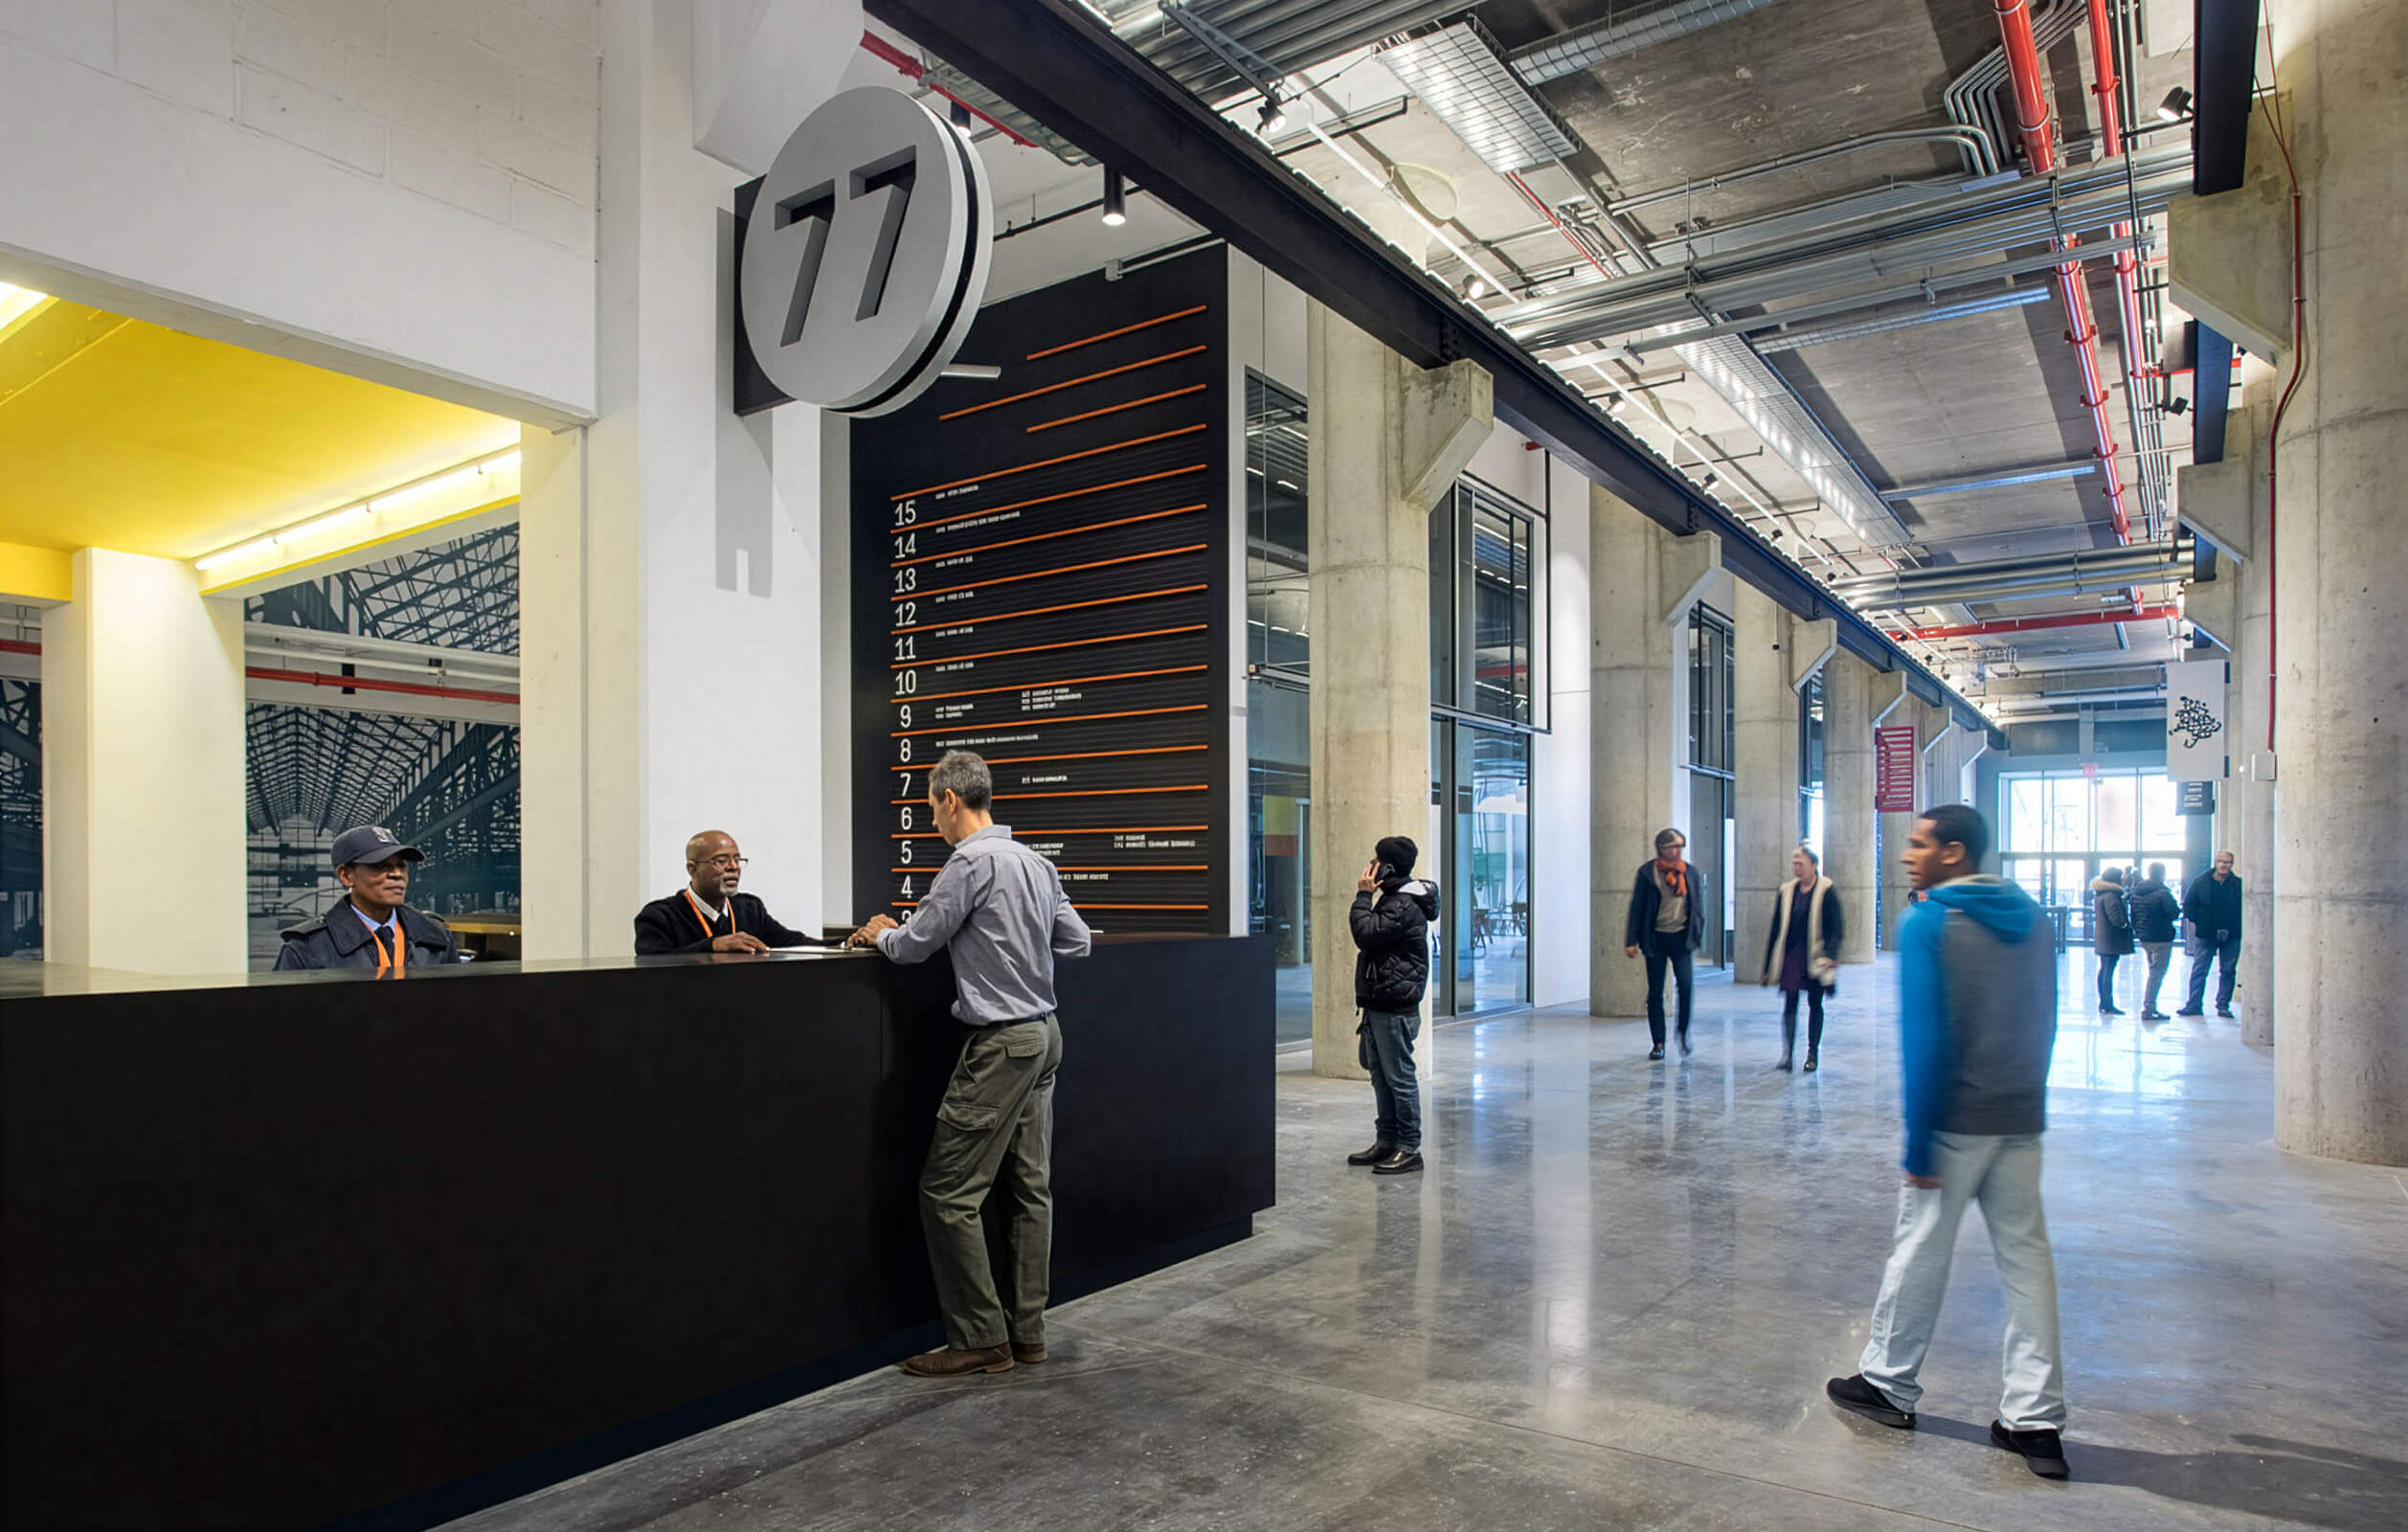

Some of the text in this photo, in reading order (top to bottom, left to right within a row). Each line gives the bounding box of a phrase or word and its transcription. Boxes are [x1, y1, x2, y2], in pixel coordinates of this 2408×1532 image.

[775, 146, 916, 348] 77
[895, 500, 916, 526] 15
[895, 533, 916, 559] 14
[895, 568, 916, 593] 13
[895, 602, 916, 626] 12
[895, 636, 916, 661] 11
[895, 669, 916, 695] 10
[900, 705, 911, 728] 9
[900, 738, 911, 762] 8
[900, 773, 911, 797] 7
[901, 807, 911, 831] 6
[901, 841, 911, 865] 5
[901, 875, 912, 898] 4
